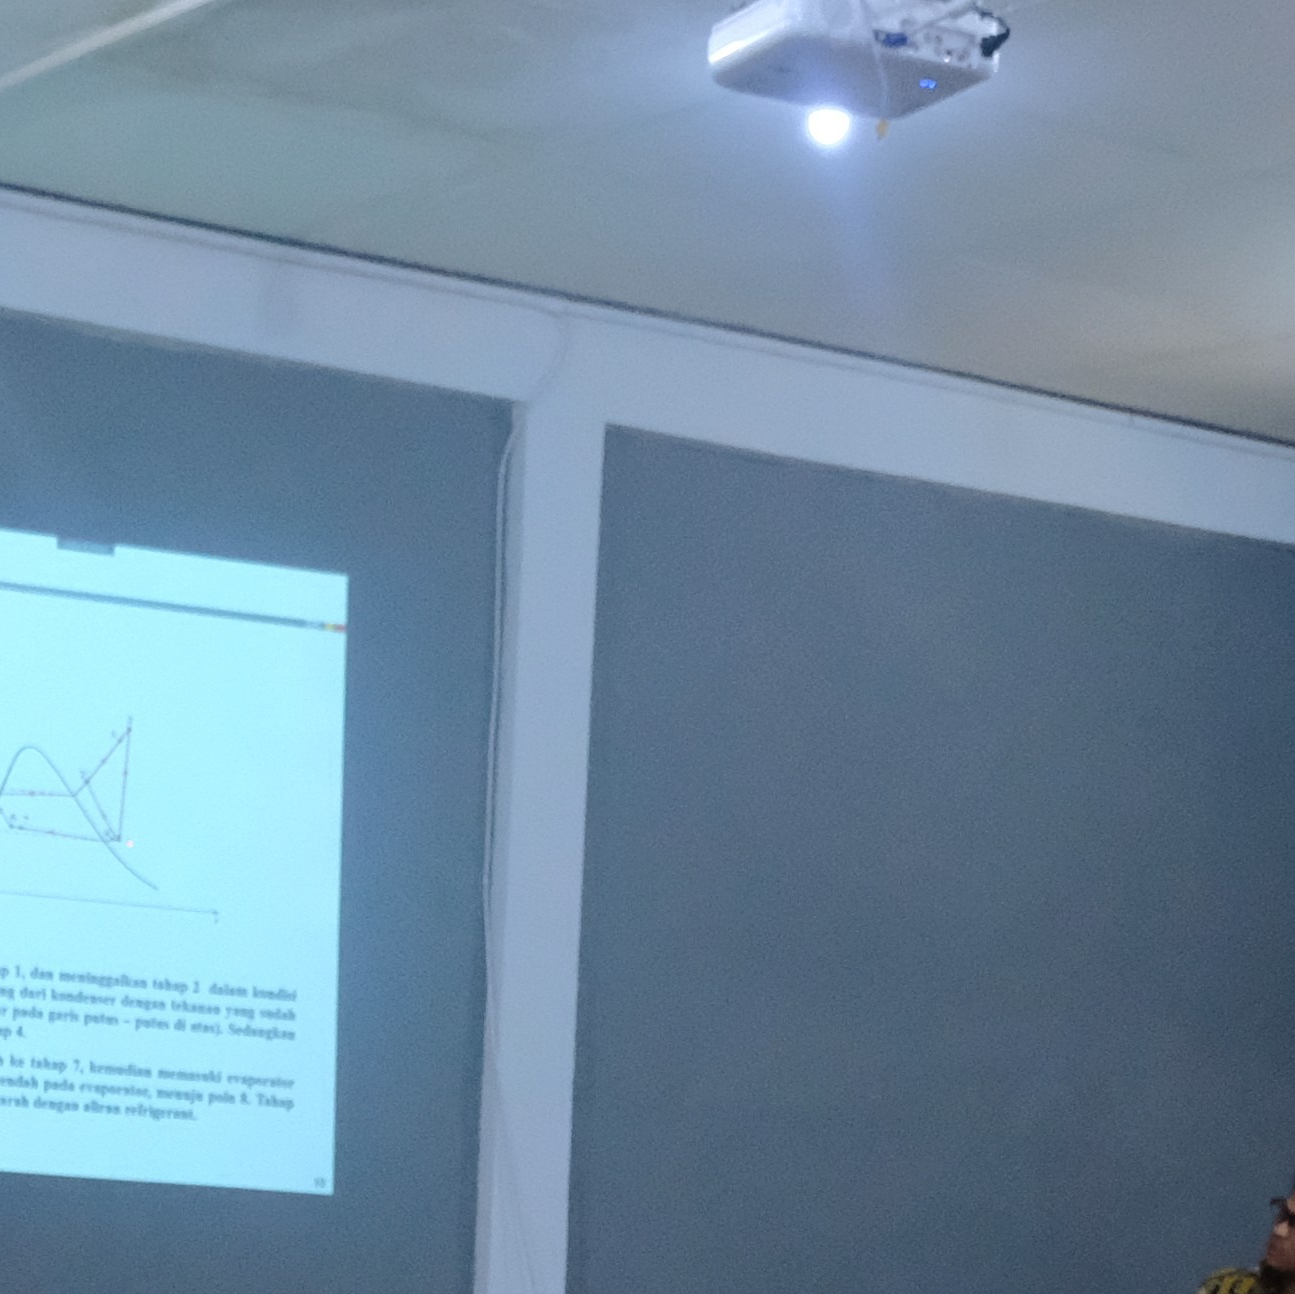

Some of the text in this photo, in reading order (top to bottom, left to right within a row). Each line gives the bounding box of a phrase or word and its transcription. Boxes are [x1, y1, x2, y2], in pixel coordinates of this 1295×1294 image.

[29, 966, 54, 980] dan
[58, 971, 148, 988] meninggalkan
[151, 978, 188, 993] tahap
[192, 979, 200, 993] 2
[208, 982, 248, 997] dalam
[251, 986, 297, 1001] kondisi
[19, 986, 46, 999] dari
[120, 995, 166, 1010] dengan
[170, 1000, 221, 1014] tekanan
[225, 1006, 255, 1019] yang
[259, 1008, 296, 1021] sudah
[11, 1006, 43, 1020] pada
[47, 1010, 79, 1023] garis
[82, 1013, 119, 1026] putus
[133, 1017, 170, 1030] putus
[173, 1018, 186, 1031] di
[227, 1023, 296, 1040] Sedangkan
[8, 1053, 24, 1067] ke
[29, 1057, 67, 1072] tahap
[72, 1057, 83, 1074] 7,
[88, 1060, 152, 1077] kemudian
[157, 1068, 222, 1082] memasuki
[226, 1074, 294, 1088] evaporator
[32, 1097, 79, 1113] dengan
[82, 1100, 121, 1114] aliran
[42, 1078, 75, 1091] pada
[155, 1088, 203, 1103] menuju
[256, 1093, 295, 1111] Tahap
